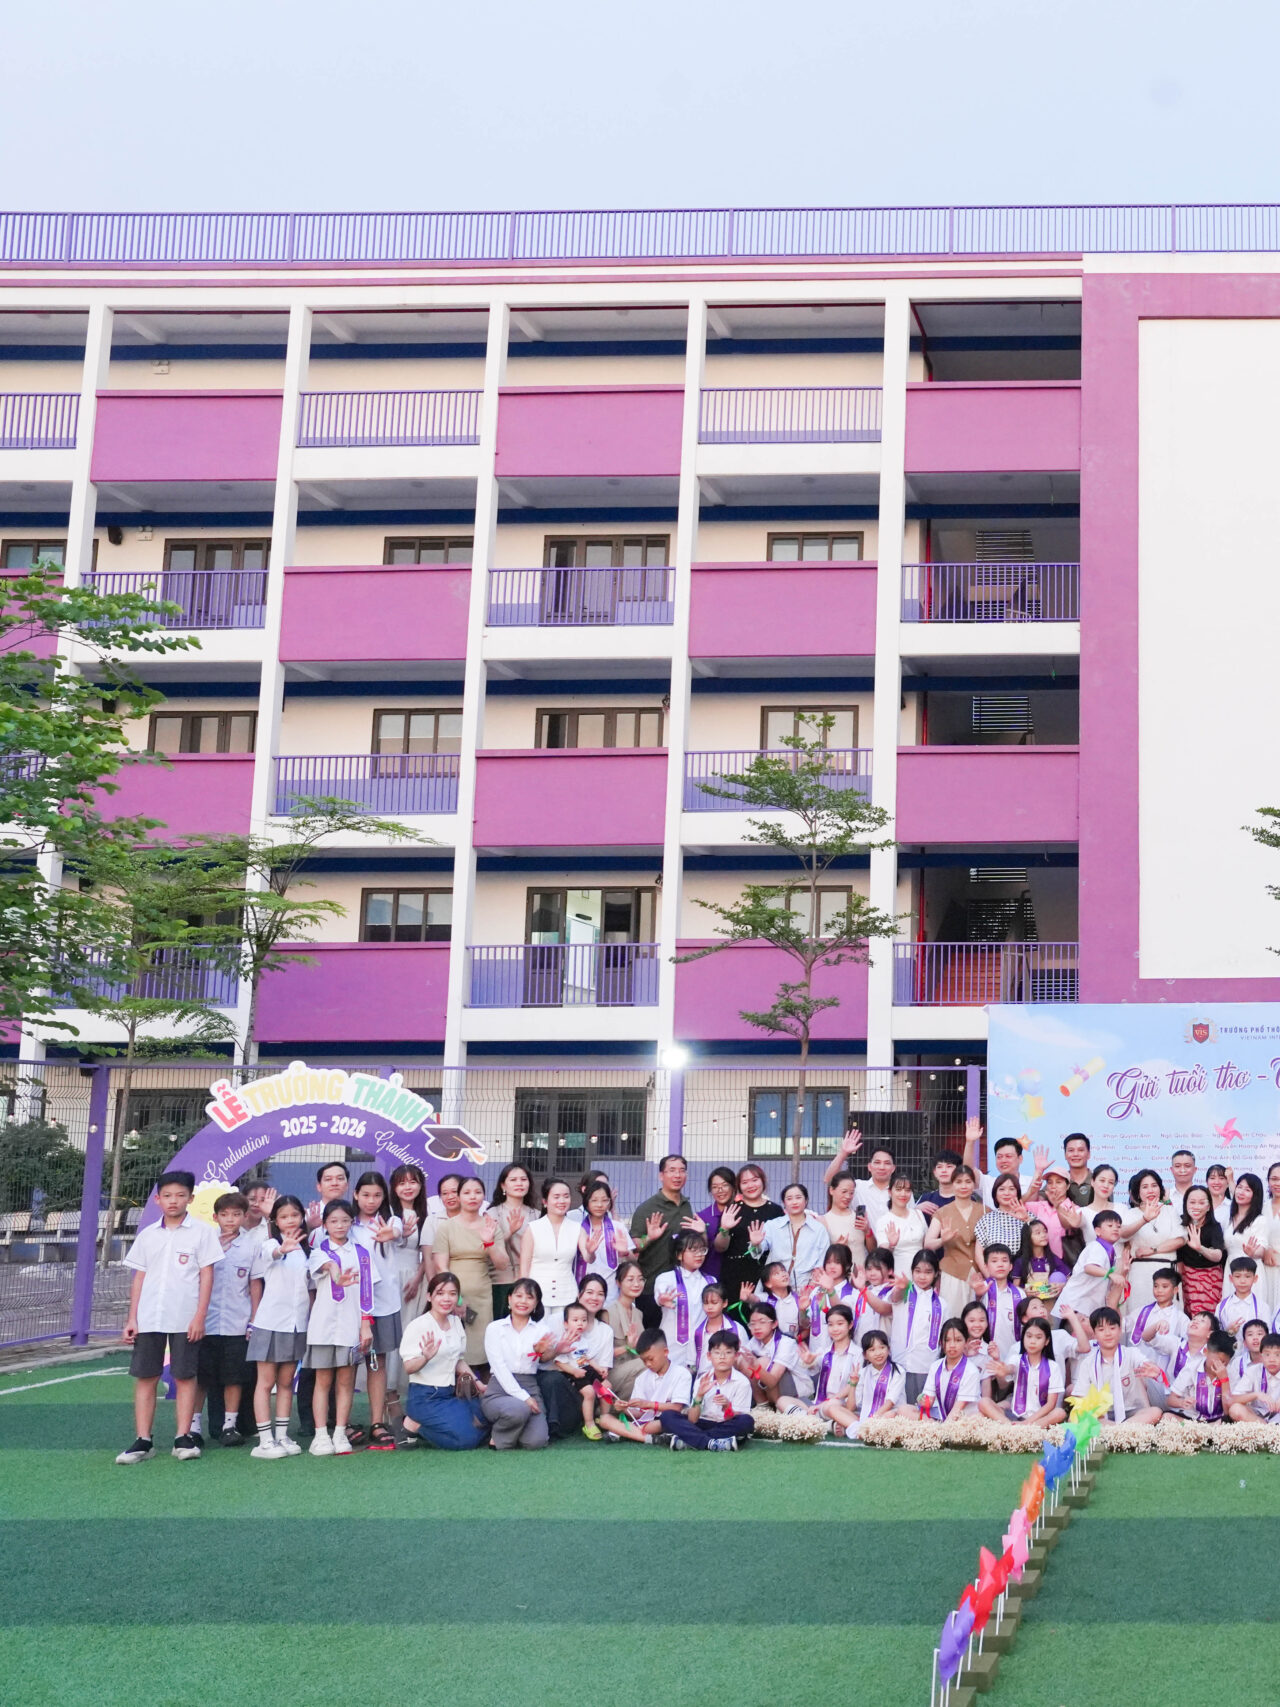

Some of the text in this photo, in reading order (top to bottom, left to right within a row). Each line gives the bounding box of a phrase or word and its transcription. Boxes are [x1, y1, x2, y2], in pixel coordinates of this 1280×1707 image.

[1194, 1029, 1208, 1037] VIS
[211, 1065, 429, 1129] LỄ TRƯỞNG THÀNH
[1107, 1067, 1160, 1120] Gửi
[1165, 1063, 1207, 1095] tuổi
[1213, 1061, 1249, 1089] thơ
[280, 1115, 317, 1138] 2025
[330, 1115, 367, 1138] 2026
[203, 1133, 270, 1181] Graduation
